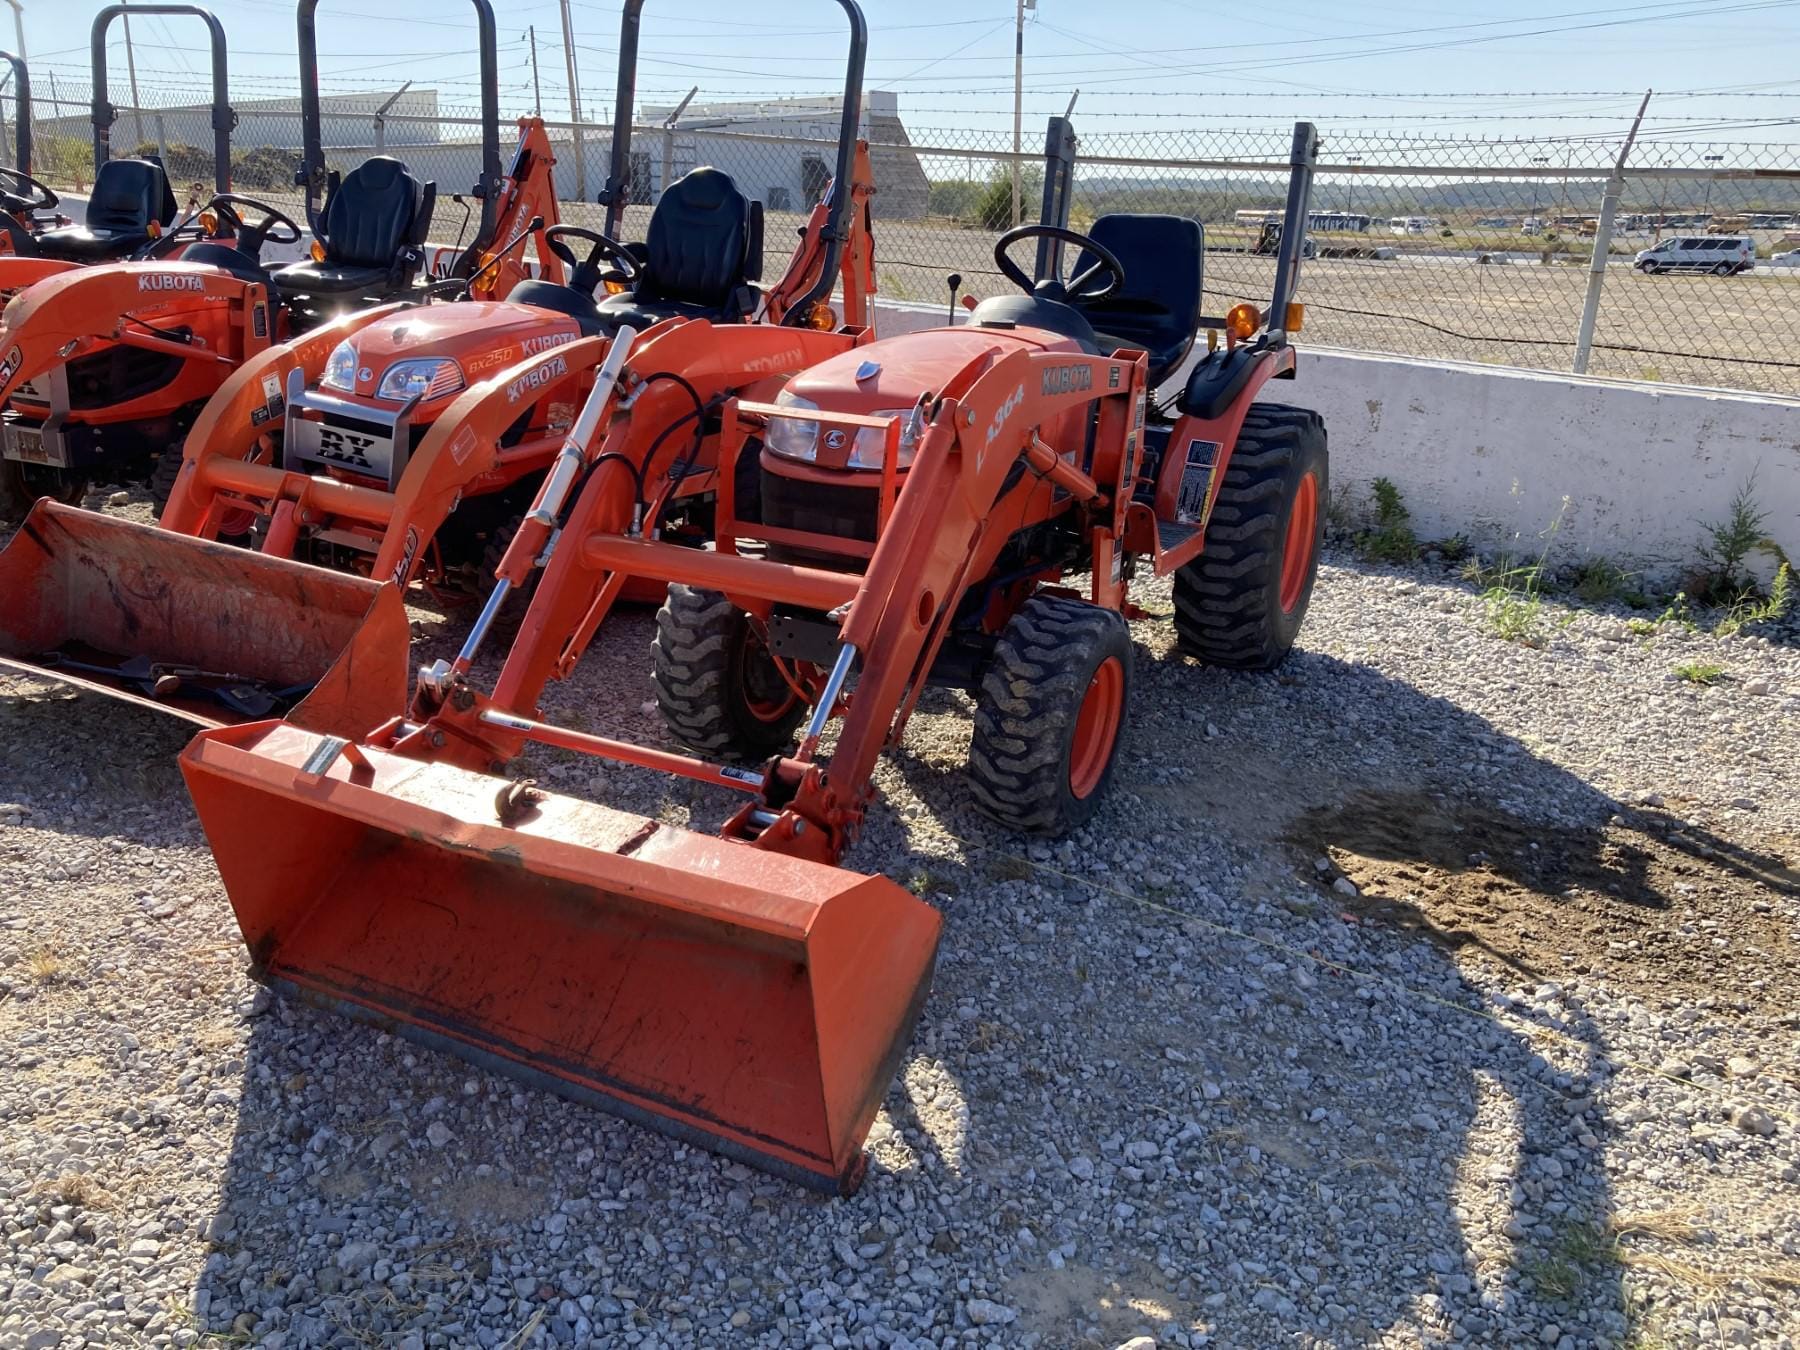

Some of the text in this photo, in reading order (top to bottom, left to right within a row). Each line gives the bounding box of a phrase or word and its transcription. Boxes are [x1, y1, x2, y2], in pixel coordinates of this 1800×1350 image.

[138, 274, 205, 291] KUBOTA
[1042, 364, 1092, 395] KUBOTA
[316, 428, 375, 469] BX
